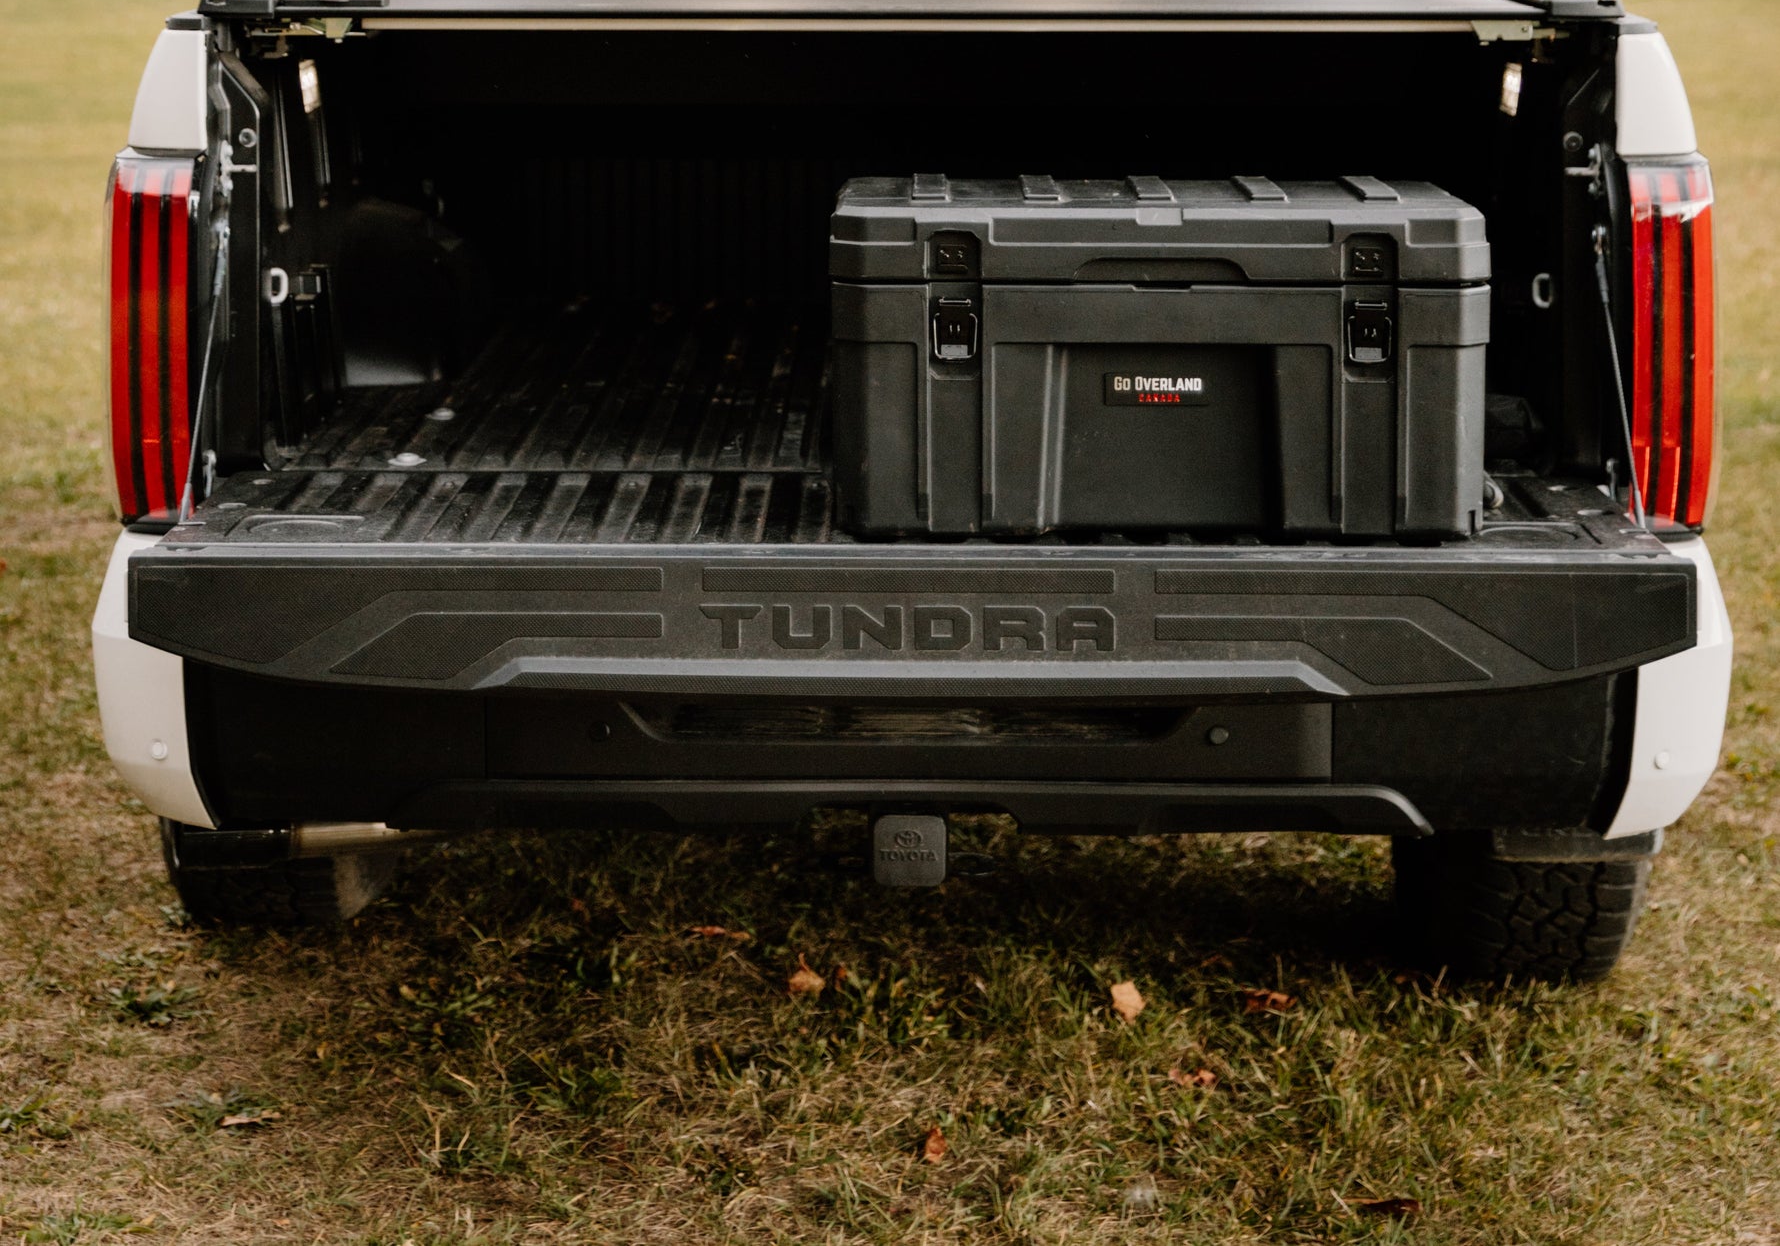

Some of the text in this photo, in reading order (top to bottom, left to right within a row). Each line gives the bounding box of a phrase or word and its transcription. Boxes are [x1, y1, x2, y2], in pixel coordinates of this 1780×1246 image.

[1134, 376, 1202, 391] OVERLAND
[1138, 393, 1181, 402] CANADA
[699, 604, 1117, 652] TUNDRA
[880, 848, 938, 861] TOYOTA
